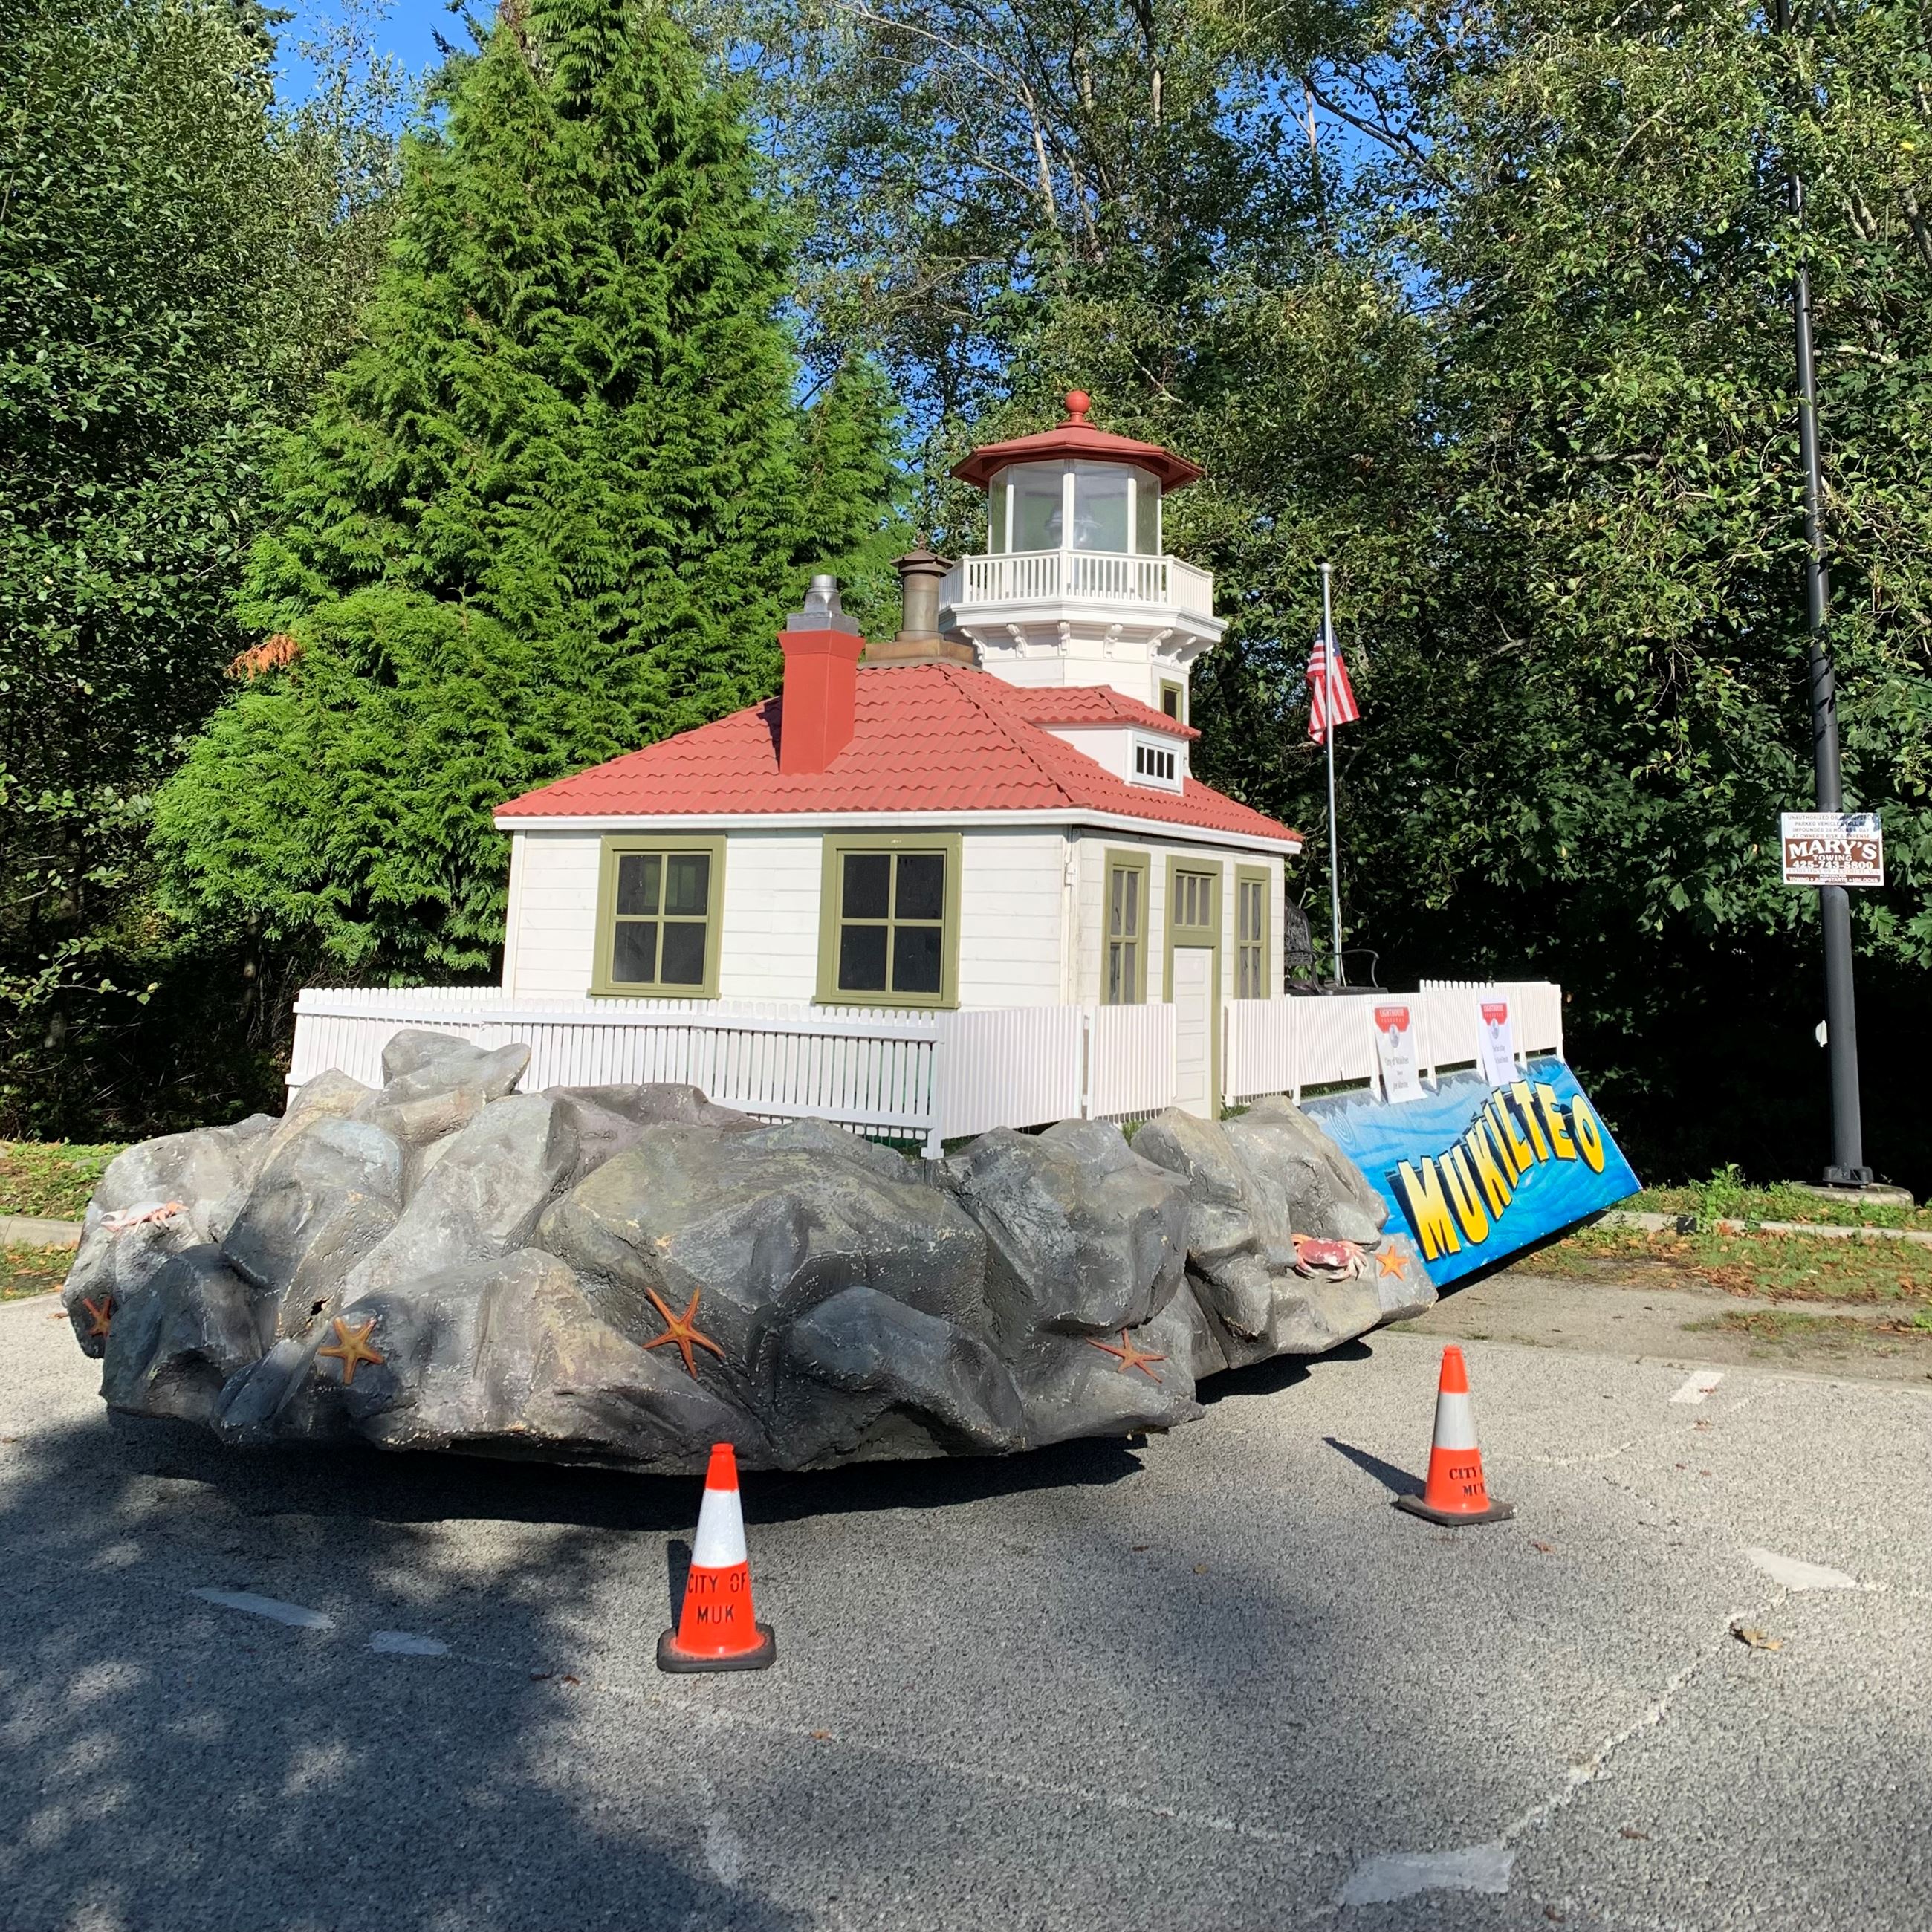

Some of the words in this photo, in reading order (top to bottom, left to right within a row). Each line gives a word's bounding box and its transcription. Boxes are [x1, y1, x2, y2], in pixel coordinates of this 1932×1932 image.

[1788, 840, 1878, 860] MARY'S
[1792, 860, 1874, 869] 425-743-5800
[1395, 1080, 1605, 1261] MUKILTEO
[1449, 1466, 1477, 1480] CITY
[687, 1574, 718, 1593] CITY
[730, 1572, 747, 1592] OF
[696, 1604, 735, 1625] MUK
